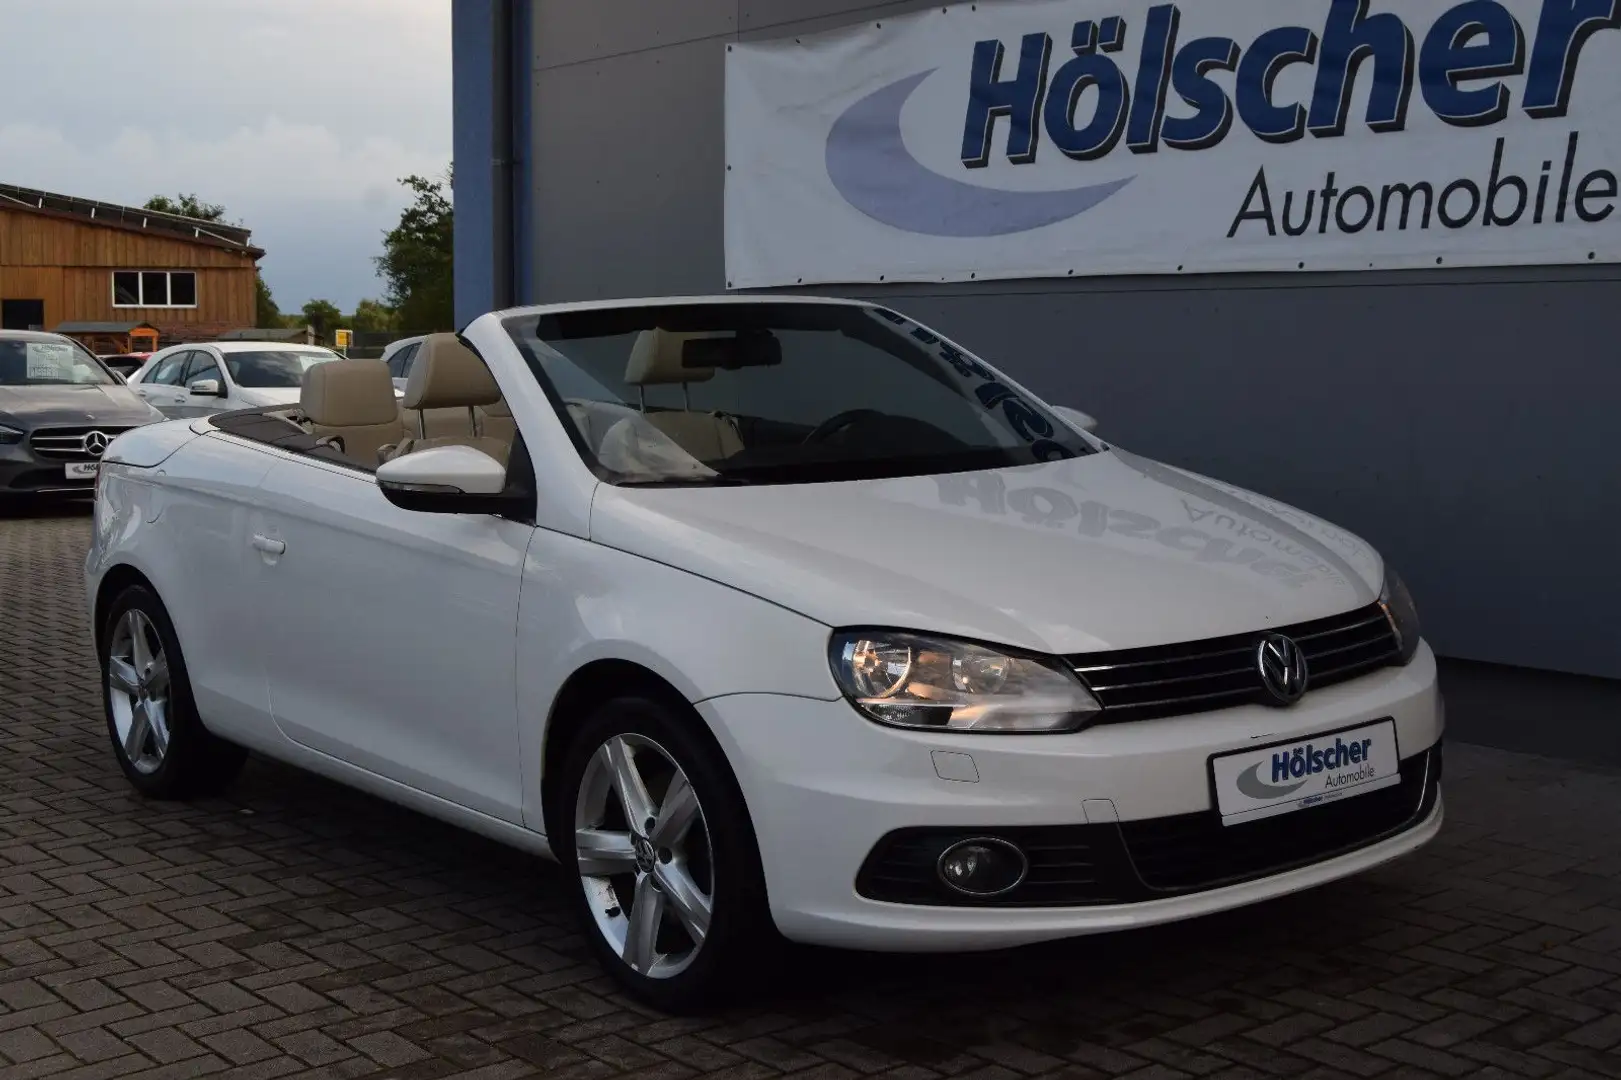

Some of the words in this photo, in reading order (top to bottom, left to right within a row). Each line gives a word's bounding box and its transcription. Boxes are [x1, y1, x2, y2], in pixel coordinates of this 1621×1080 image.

[960, 0, 1621, 169] Hölscher
[1226, 131, 1617, 239] Automobile
[1271, 738, 1371, 783] Hölscher
[1325, 763, 1375, 788] Automobile
